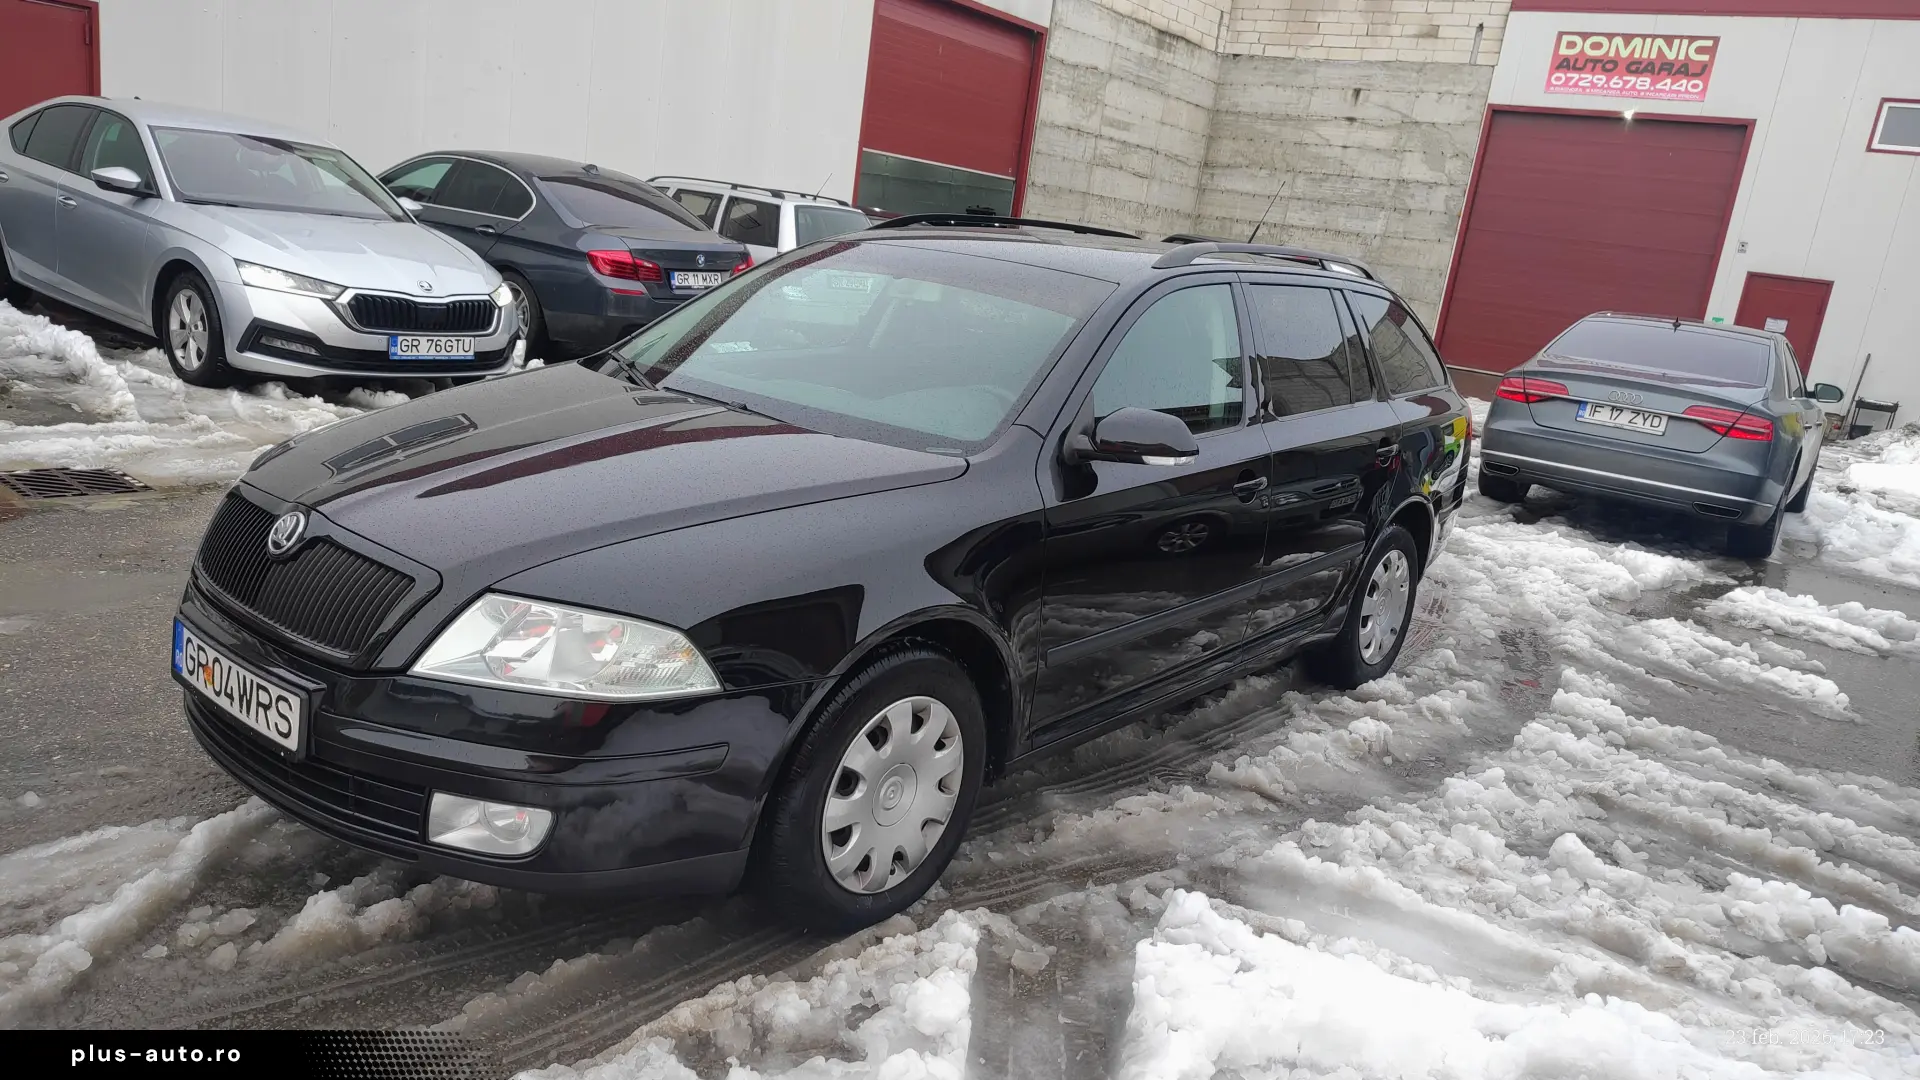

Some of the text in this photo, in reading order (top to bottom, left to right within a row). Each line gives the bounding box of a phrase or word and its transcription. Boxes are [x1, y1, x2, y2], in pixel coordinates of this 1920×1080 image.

[1558, 34, 1714, 62] DOMINIC
[1555, 57, 1708, 78] AUTO GARAJ
[1551, 72, 1704, 93] 0729.678.440
[677, 273, 719, 285] GR 11 MXR
[399, 338, 472, 353] GR 76GTU
[1588, 404, 1662, 429] IF 17 ZYD
